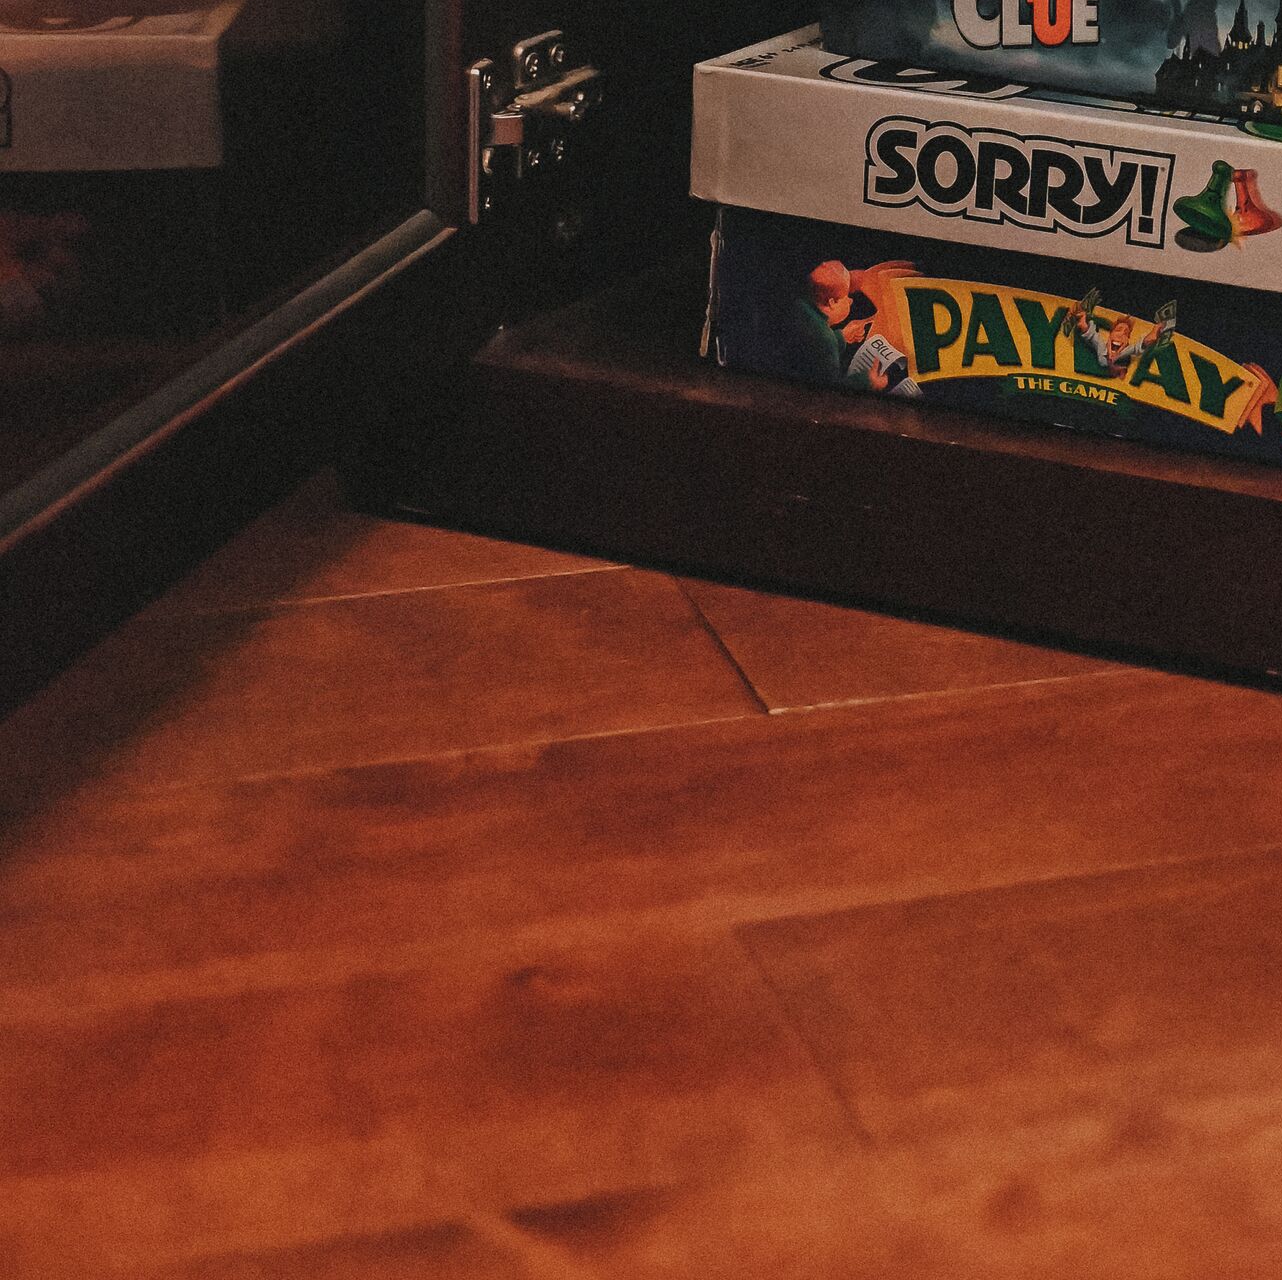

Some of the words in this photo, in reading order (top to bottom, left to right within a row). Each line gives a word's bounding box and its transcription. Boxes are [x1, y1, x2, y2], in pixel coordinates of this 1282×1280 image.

[872, 126, 1162, 237] SORRY!
[870, 338, 894, 361] BILL
[1013, 376, 1056, 392] THE
[1059, 381, 1120, 406] GAME
